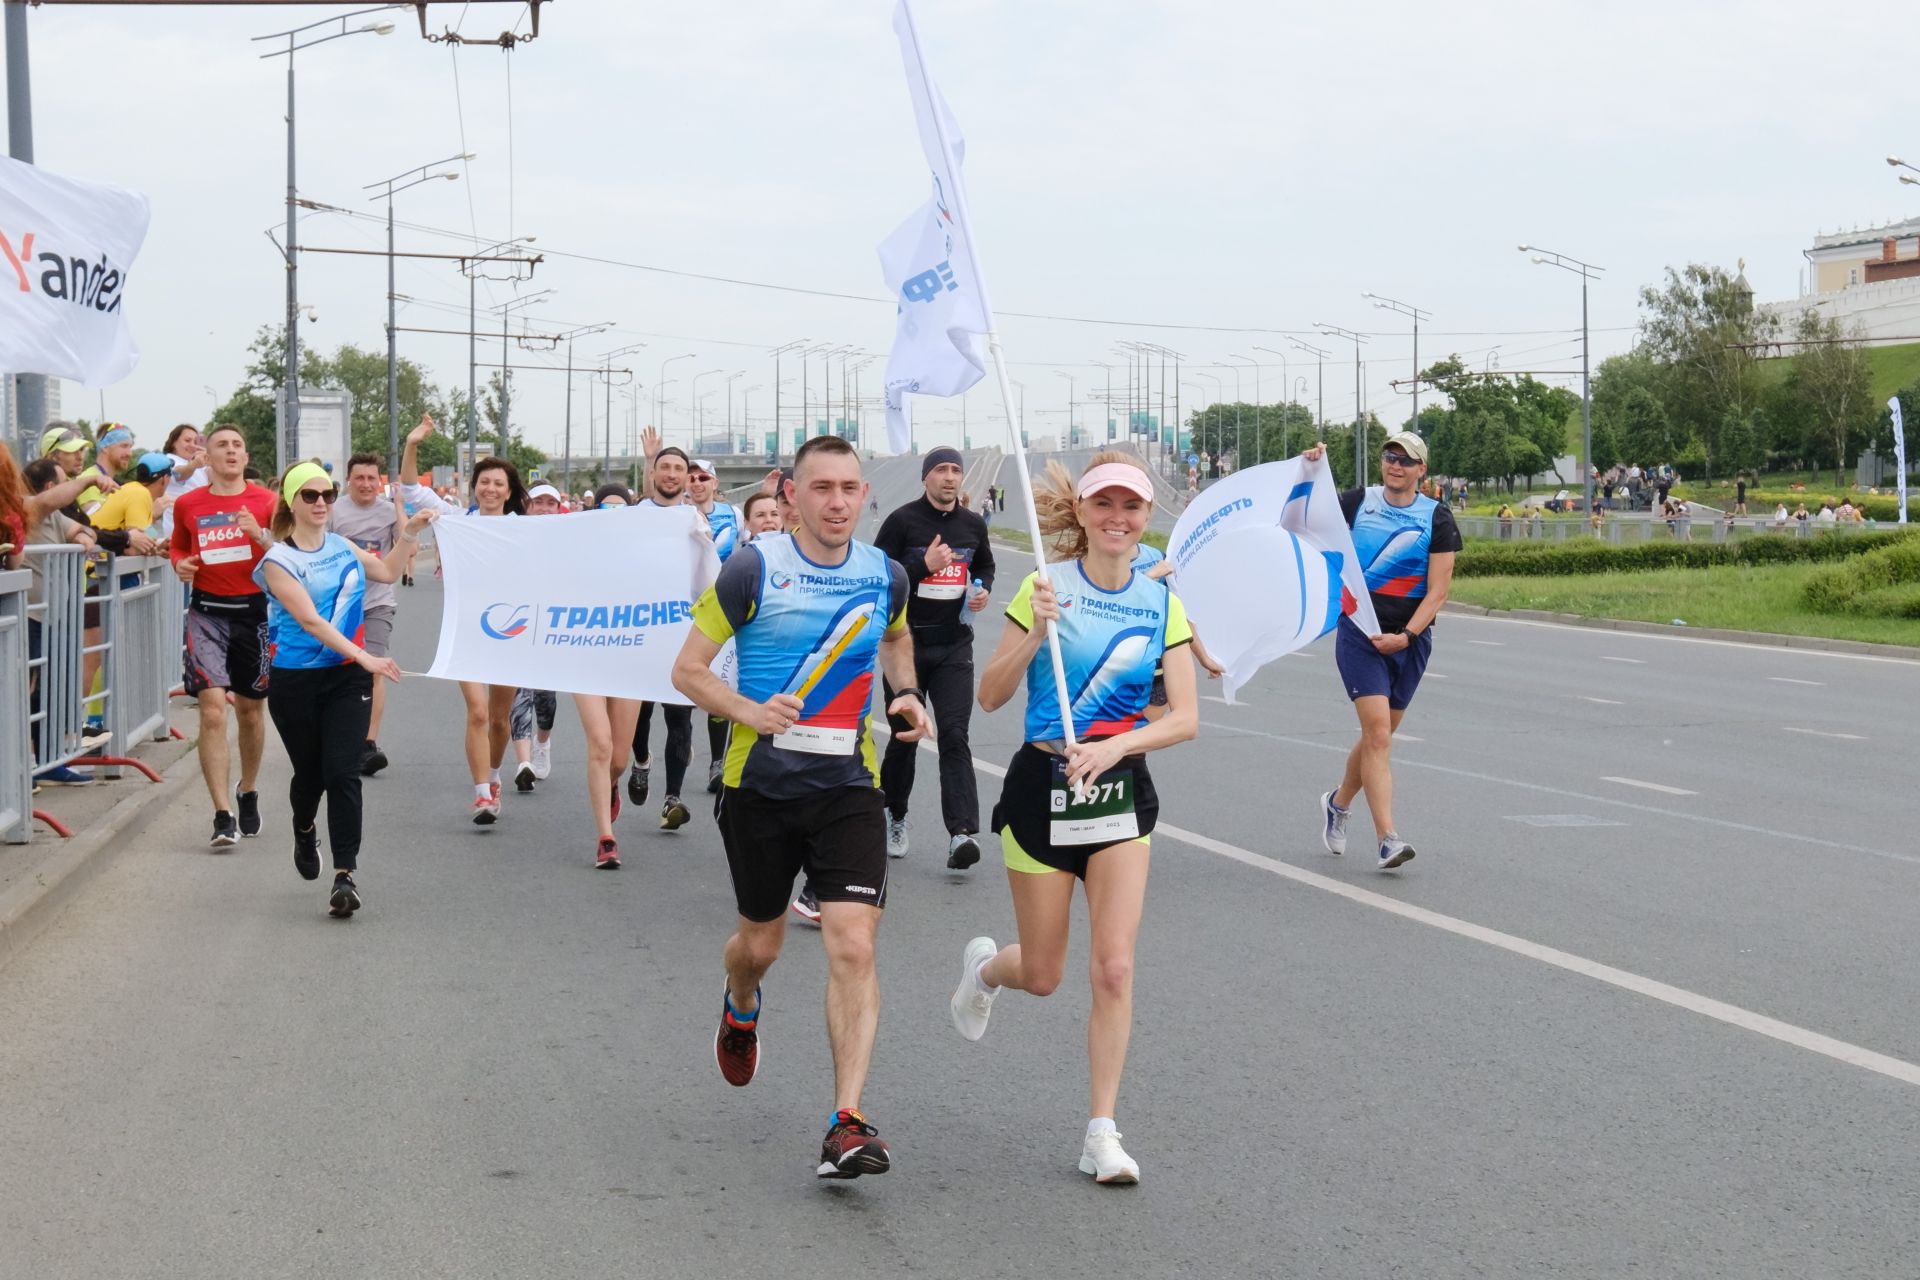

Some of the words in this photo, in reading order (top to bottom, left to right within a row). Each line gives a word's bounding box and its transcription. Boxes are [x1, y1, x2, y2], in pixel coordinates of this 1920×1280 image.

[207, 527, 244, 541] 4664
[799, 574, 883, 586] ТРАНСНЕФТЬ
[799, 586, 852, 596] ПРИКАМЬЕ
[1081, 595, 1160, 620] ТРАНСНЕФТЬ
[1080, 607, 1127, 624] ПРИКАМЬЕ
[544, 633, 645, 647] ПРИКАМЬЕ
[1054, 796, 1063, 807] C
[845, 885, 877, 895] KIPSTA
